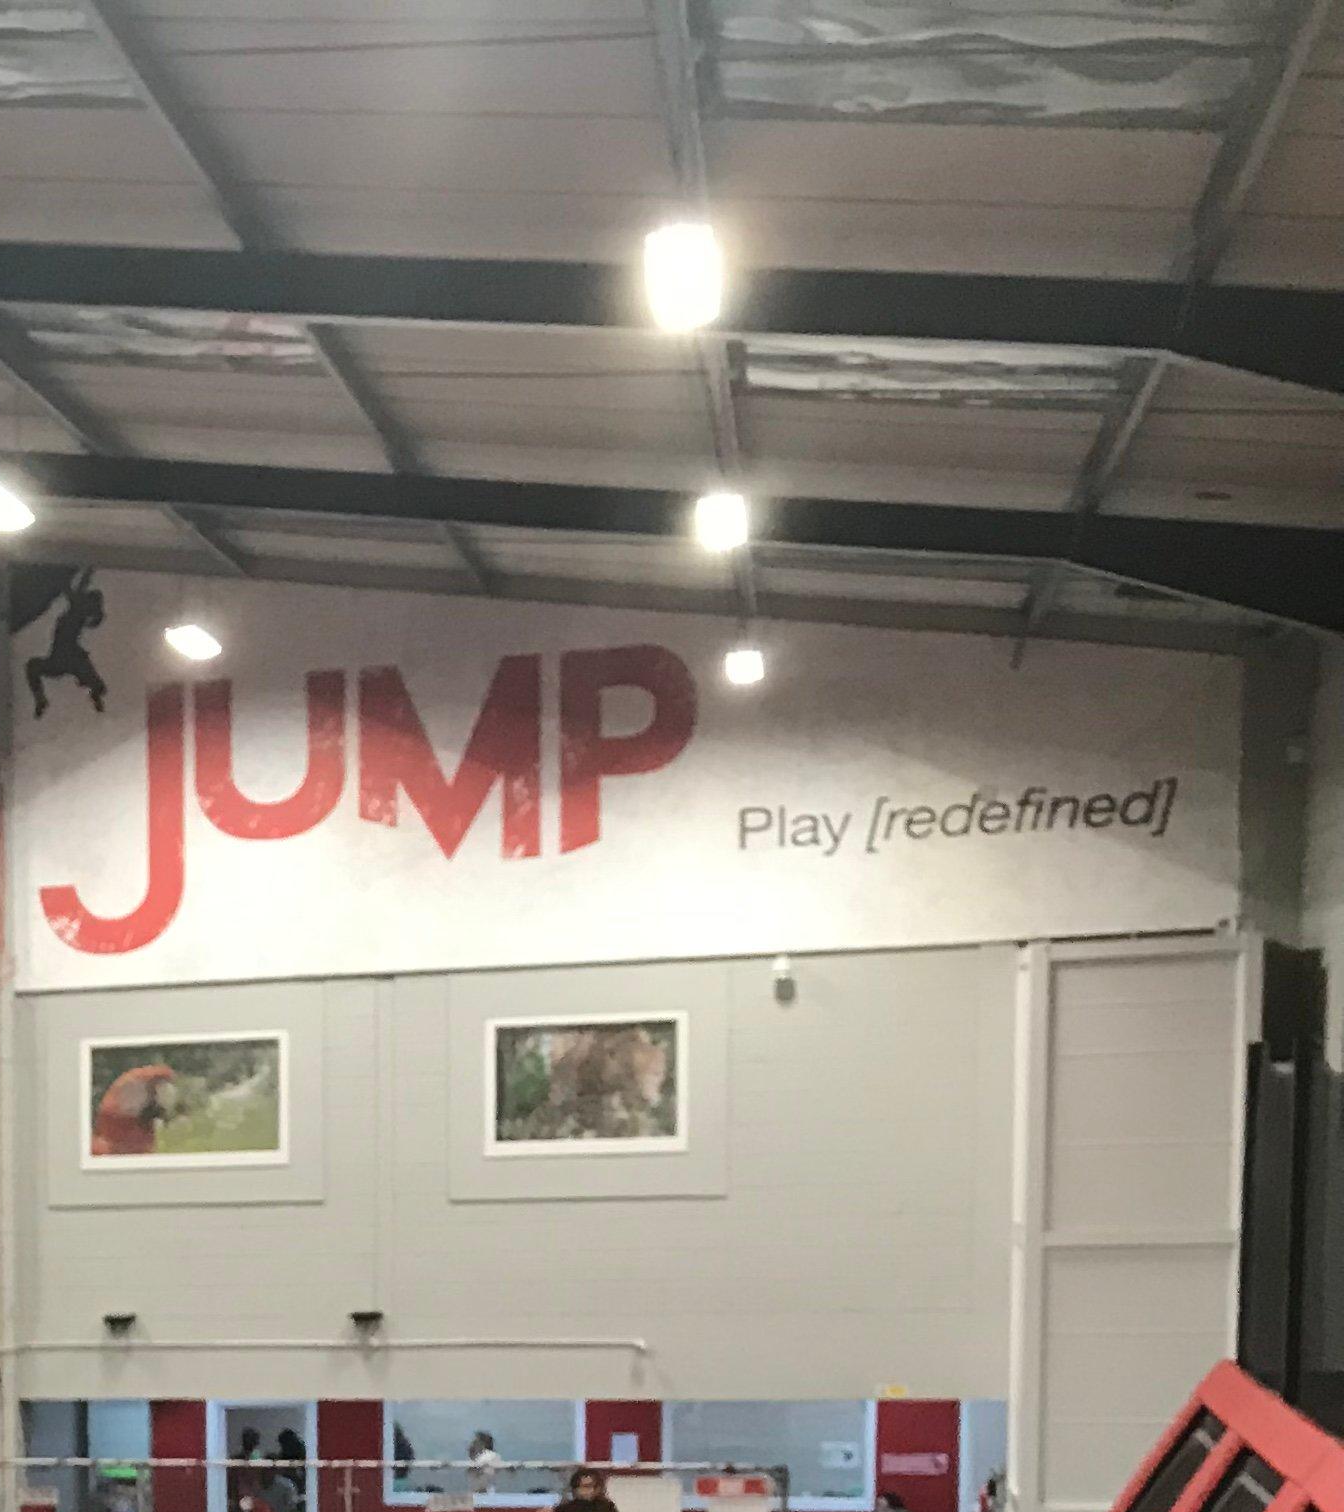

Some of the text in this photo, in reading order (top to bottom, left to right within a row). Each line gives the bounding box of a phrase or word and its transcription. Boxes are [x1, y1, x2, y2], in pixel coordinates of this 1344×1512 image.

[39, 642, 699, 955] JUMP
[737, 776, 1179, 857] Play [redefined]
